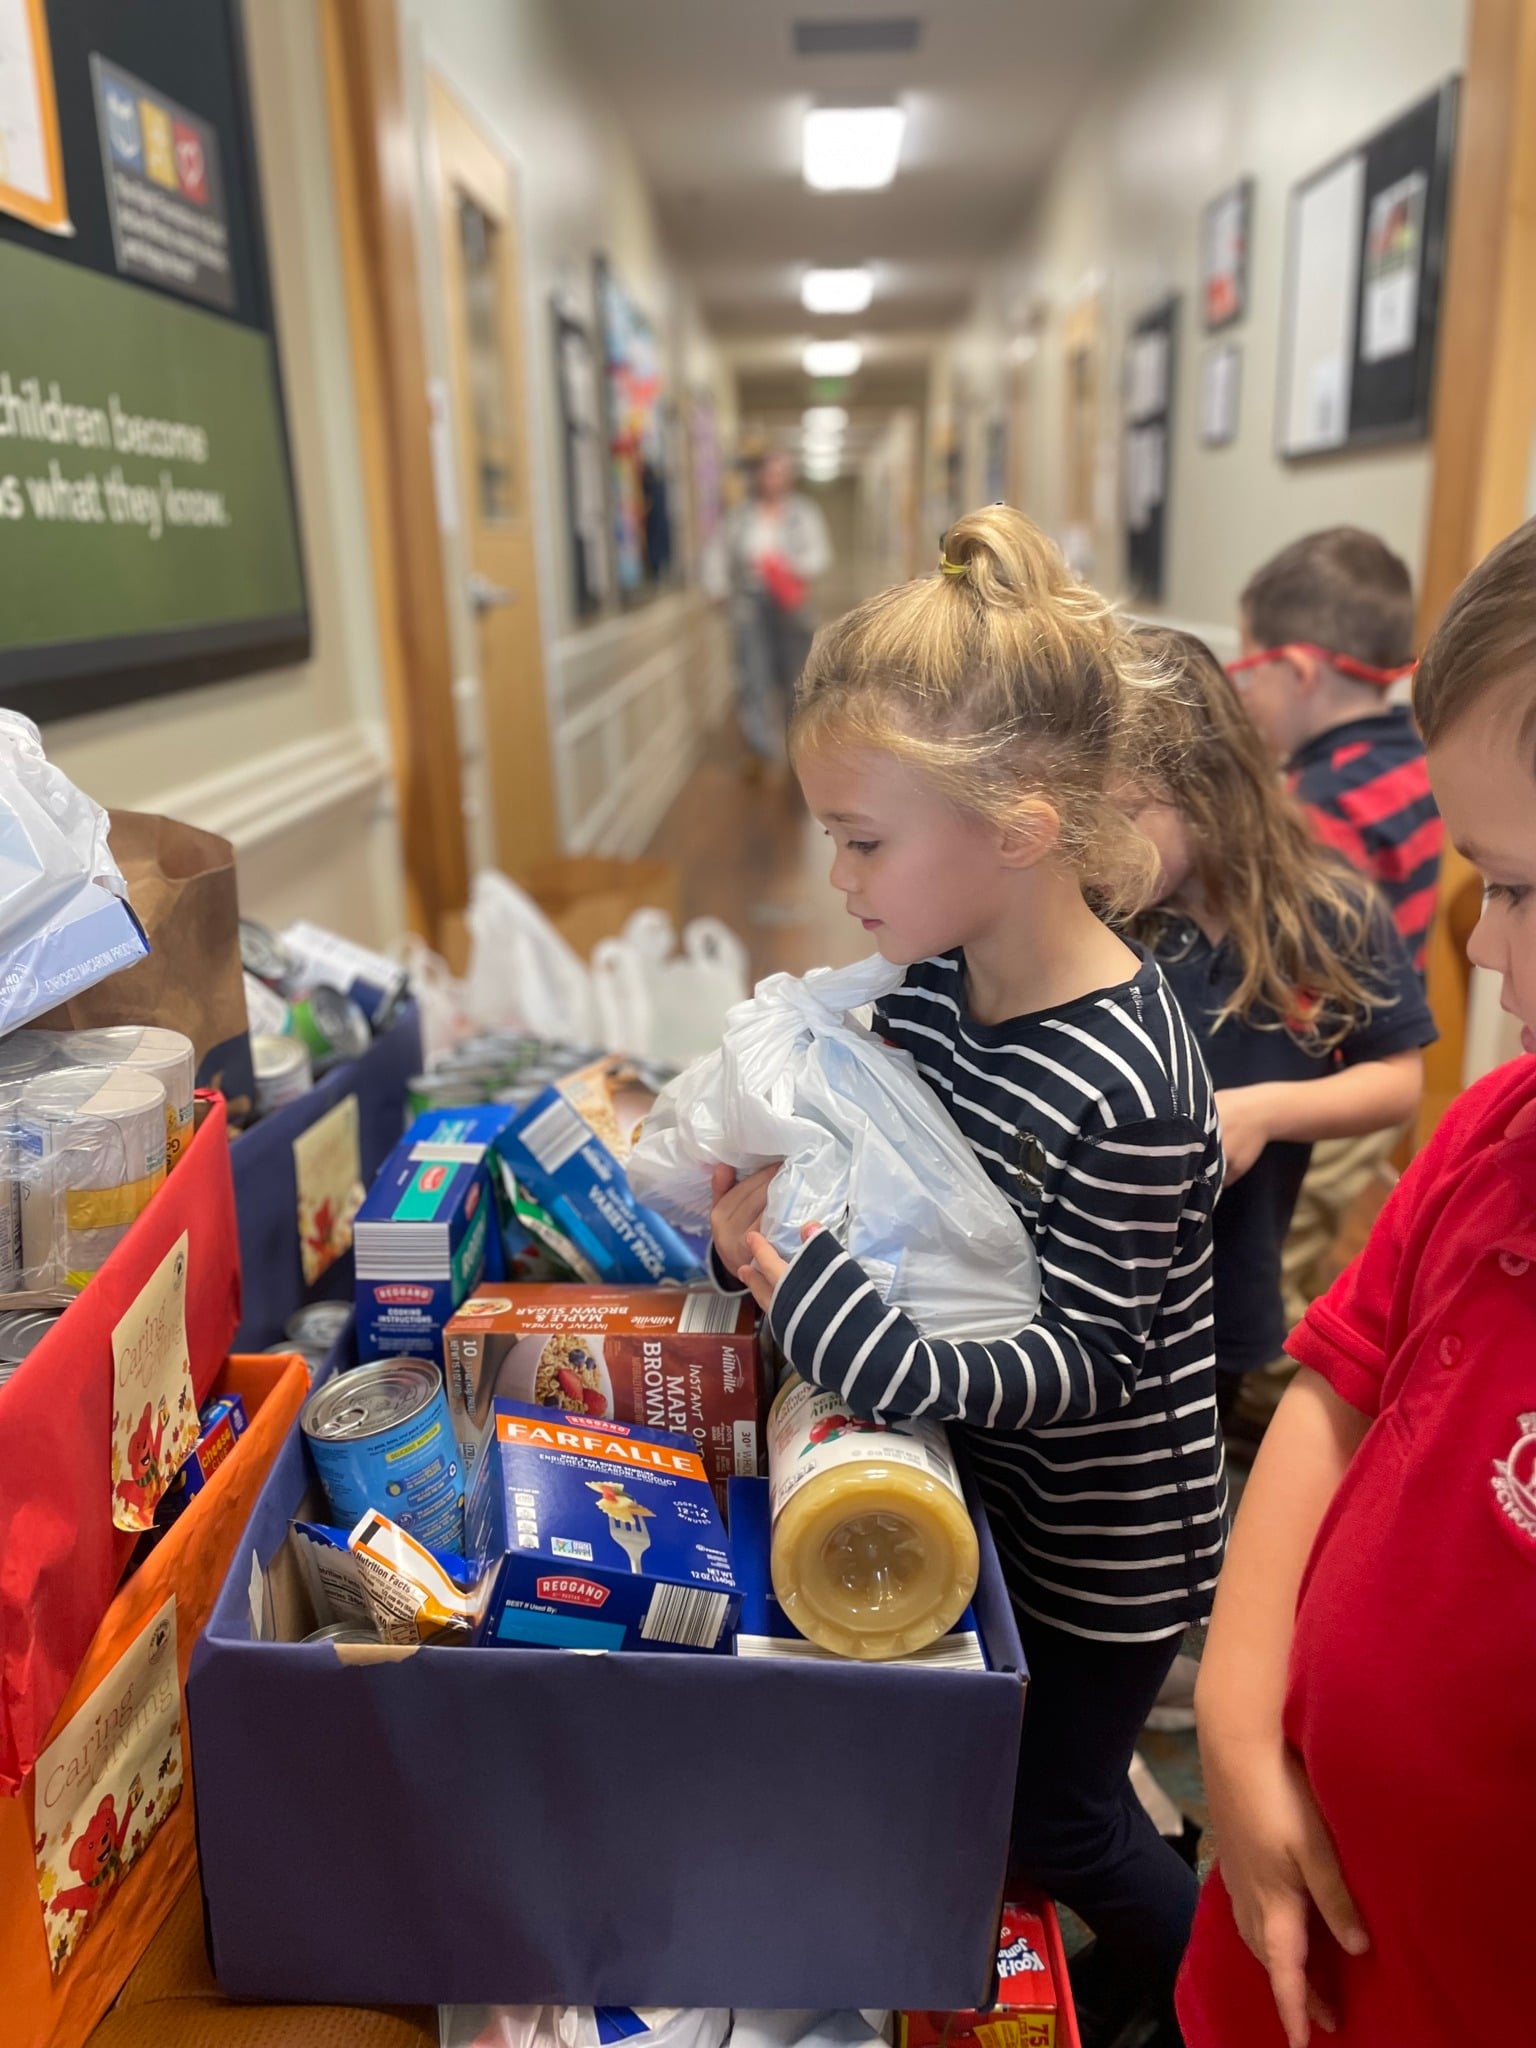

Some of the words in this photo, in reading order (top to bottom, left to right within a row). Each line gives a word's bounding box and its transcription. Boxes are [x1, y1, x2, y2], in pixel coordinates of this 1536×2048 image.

[24, 457, 105, 523] what
[103, 464, 163, 541] they
[516, 1306, 568, 1316] SUGAR
[549, 1314, 604, 1322] MAPLE
[569, 1306, 630, 1315] BROWN
[463, 1340, 478, 1357] 10
[721, 1345, 737, 1394] Millville
[643, 1341, 666, 1427] BROWN
[689, 1364, 704, 1422] INSTANT
[666, 1375, 688, 1433] MAP
[202, 1428, 232, 1468] cheese
[506, 1423, 695, 1473] FARFALLE
[539, 1453, 586, 1470] ENRICHED
[676, 1506, 708, 1520] 12-14
[355, 1552, 388, 1579] Nutrition
[389, 1574, 411, 1594] Facts
[542, 1579, 604, 1600] REGGANO
[505, 1600, 524, 1609] BEST
[529, 1603, 546, 1612] Used
[996, 1951, 1046, 1978] Kool-A
[1028, 2023, 1049, 2046] 75
